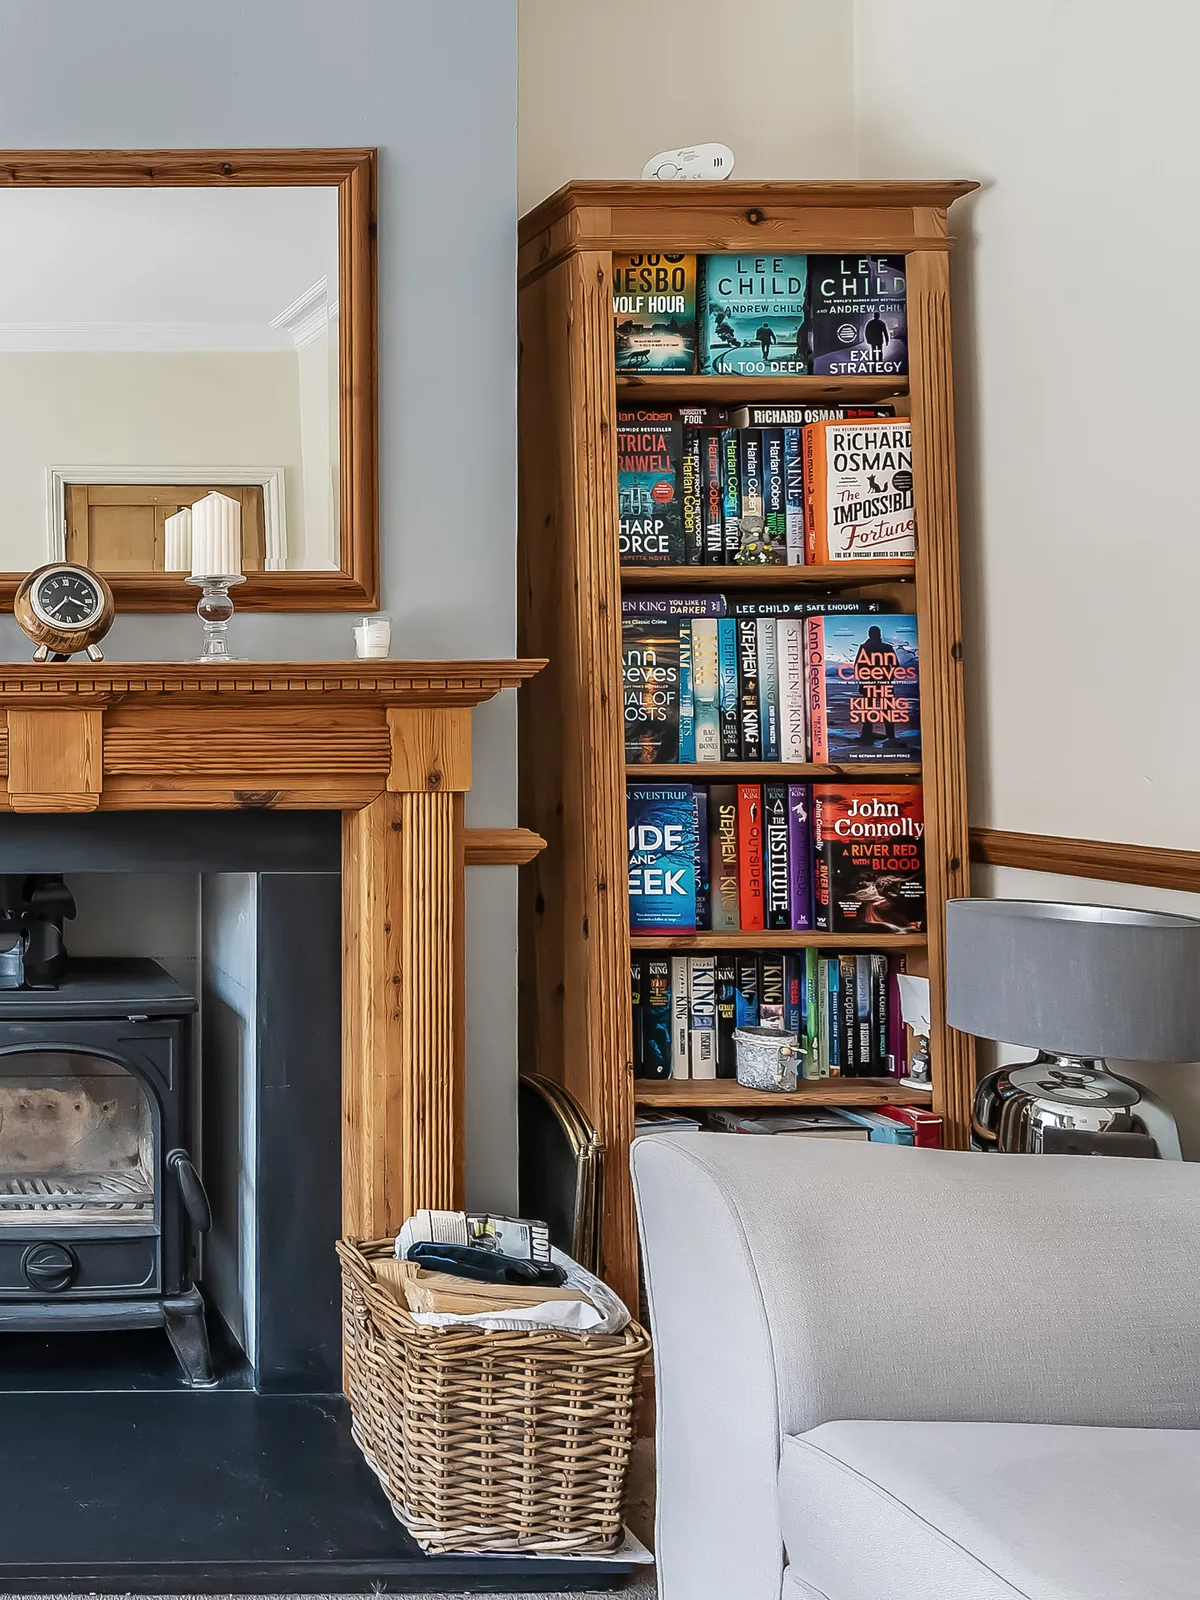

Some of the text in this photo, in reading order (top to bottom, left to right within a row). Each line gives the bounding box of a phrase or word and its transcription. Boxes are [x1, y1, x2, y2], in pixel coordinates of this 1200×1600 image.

[737, 258, 784, 274] LEE
[840, 258, 888, 275] LEE
[718, 277, 802, 296] CHILD
[820, 277, 906, 297] CHILD
[648, 295, 685, 313] HOUR
[725, 304, 803, 313] ANDREW CHILD
[850, 349, 882, 362] EXIT
[718, 361, 804, 373] IN TOO DEEP
[829, 361, 902, 374] STRATEGY
[636, 410, 673, 422] Coben
[684, 415, 704, 424] FOOL
[804, 409, 844, 423] OSMAN
[833, 451, 913, 473] OSMAN
[708, 437, 720, 521] Harlan Coben
[726, 439, 739, 513] Harlan Coben
[746, 441, 758, 513] Harlan Coben
[769, 440, 781, 510] Harlan Coben
[787, 456, 803, 501] NINE
[682, 455, 697, 533] Harlan Coben
[837, 489, 860, 503] The
[619, 519, 664, 535] HARP
[766, 511, 777, 535] TWICE
[776, 513, 786, 535] THINK
[706, 522, 722, 551] WIN
[725, 516, 739, 550] MATCH
[841, 519, 914, 551] Fortune
[619, 535, 670, 553] ORCE
[639, 601, 667, 612] KING
[669, 606, 707, 614] DARKER
[736, 604, 790, 614] LEE CHILD
[827, 603, 859, 611] ENOUGH
[740, 621, 757, 678] STEPHEN
[856, 648, 897, 666] Ann
[764, 624, 775, 700] STEPHEN KING
[786, 629, 799, 691] STEPHEN
[809, 620, 823, 711] Ann Cleeves
[724, 629, 737, 720] STEPHEN KING
[837, 664, 917, 681] Cleeves
[624, 691, 676, 706] IAL OF
[863, 685, 893, 698] THE
[624, 707, 667, 721] OSTS
[768, 705, 776, 717] END
[850, 698, 909, 711] KILLING
[742, 709, 759, 743] KING
[768, 717, 776, 725] OF
[850, 710, 910, 724] STONES
[789, 709, 802, 745] KING
[633, 791, 687, 800] SVEISTRUP
[815, 799, 823, 818] John
[847, 798, 899, 817] John
[628, 825, 683, 851] IDE
[719, 804, 737, 863] STEPHEN
[814, 818, 823, 851] Connolly
[834, 817, 924, 840] Connolly
[629, 855, 657, 865] AND
[851, 845, 890, 857] RIVER
[892, 844, 917, 856] RED
[748, 827, 760, 898] OUTSIDER
[767, 824, 789, 912] INSTITUTE
[872, 858, 921, 870] BLOOD
[628, 869, 688, 895] EEK
[720, 876, 738, 912] KING
[649, 966, 668, 975] KING
[718, 970, 735, 980] KING
[691, 967, 714, 1014] KING
[741, 967, 756, 998] KING
[763, 965, 782, 1003] KING
[675, 995, 688, 1020] KING
[700, 1032, 711, 1061] INSOMNIA
